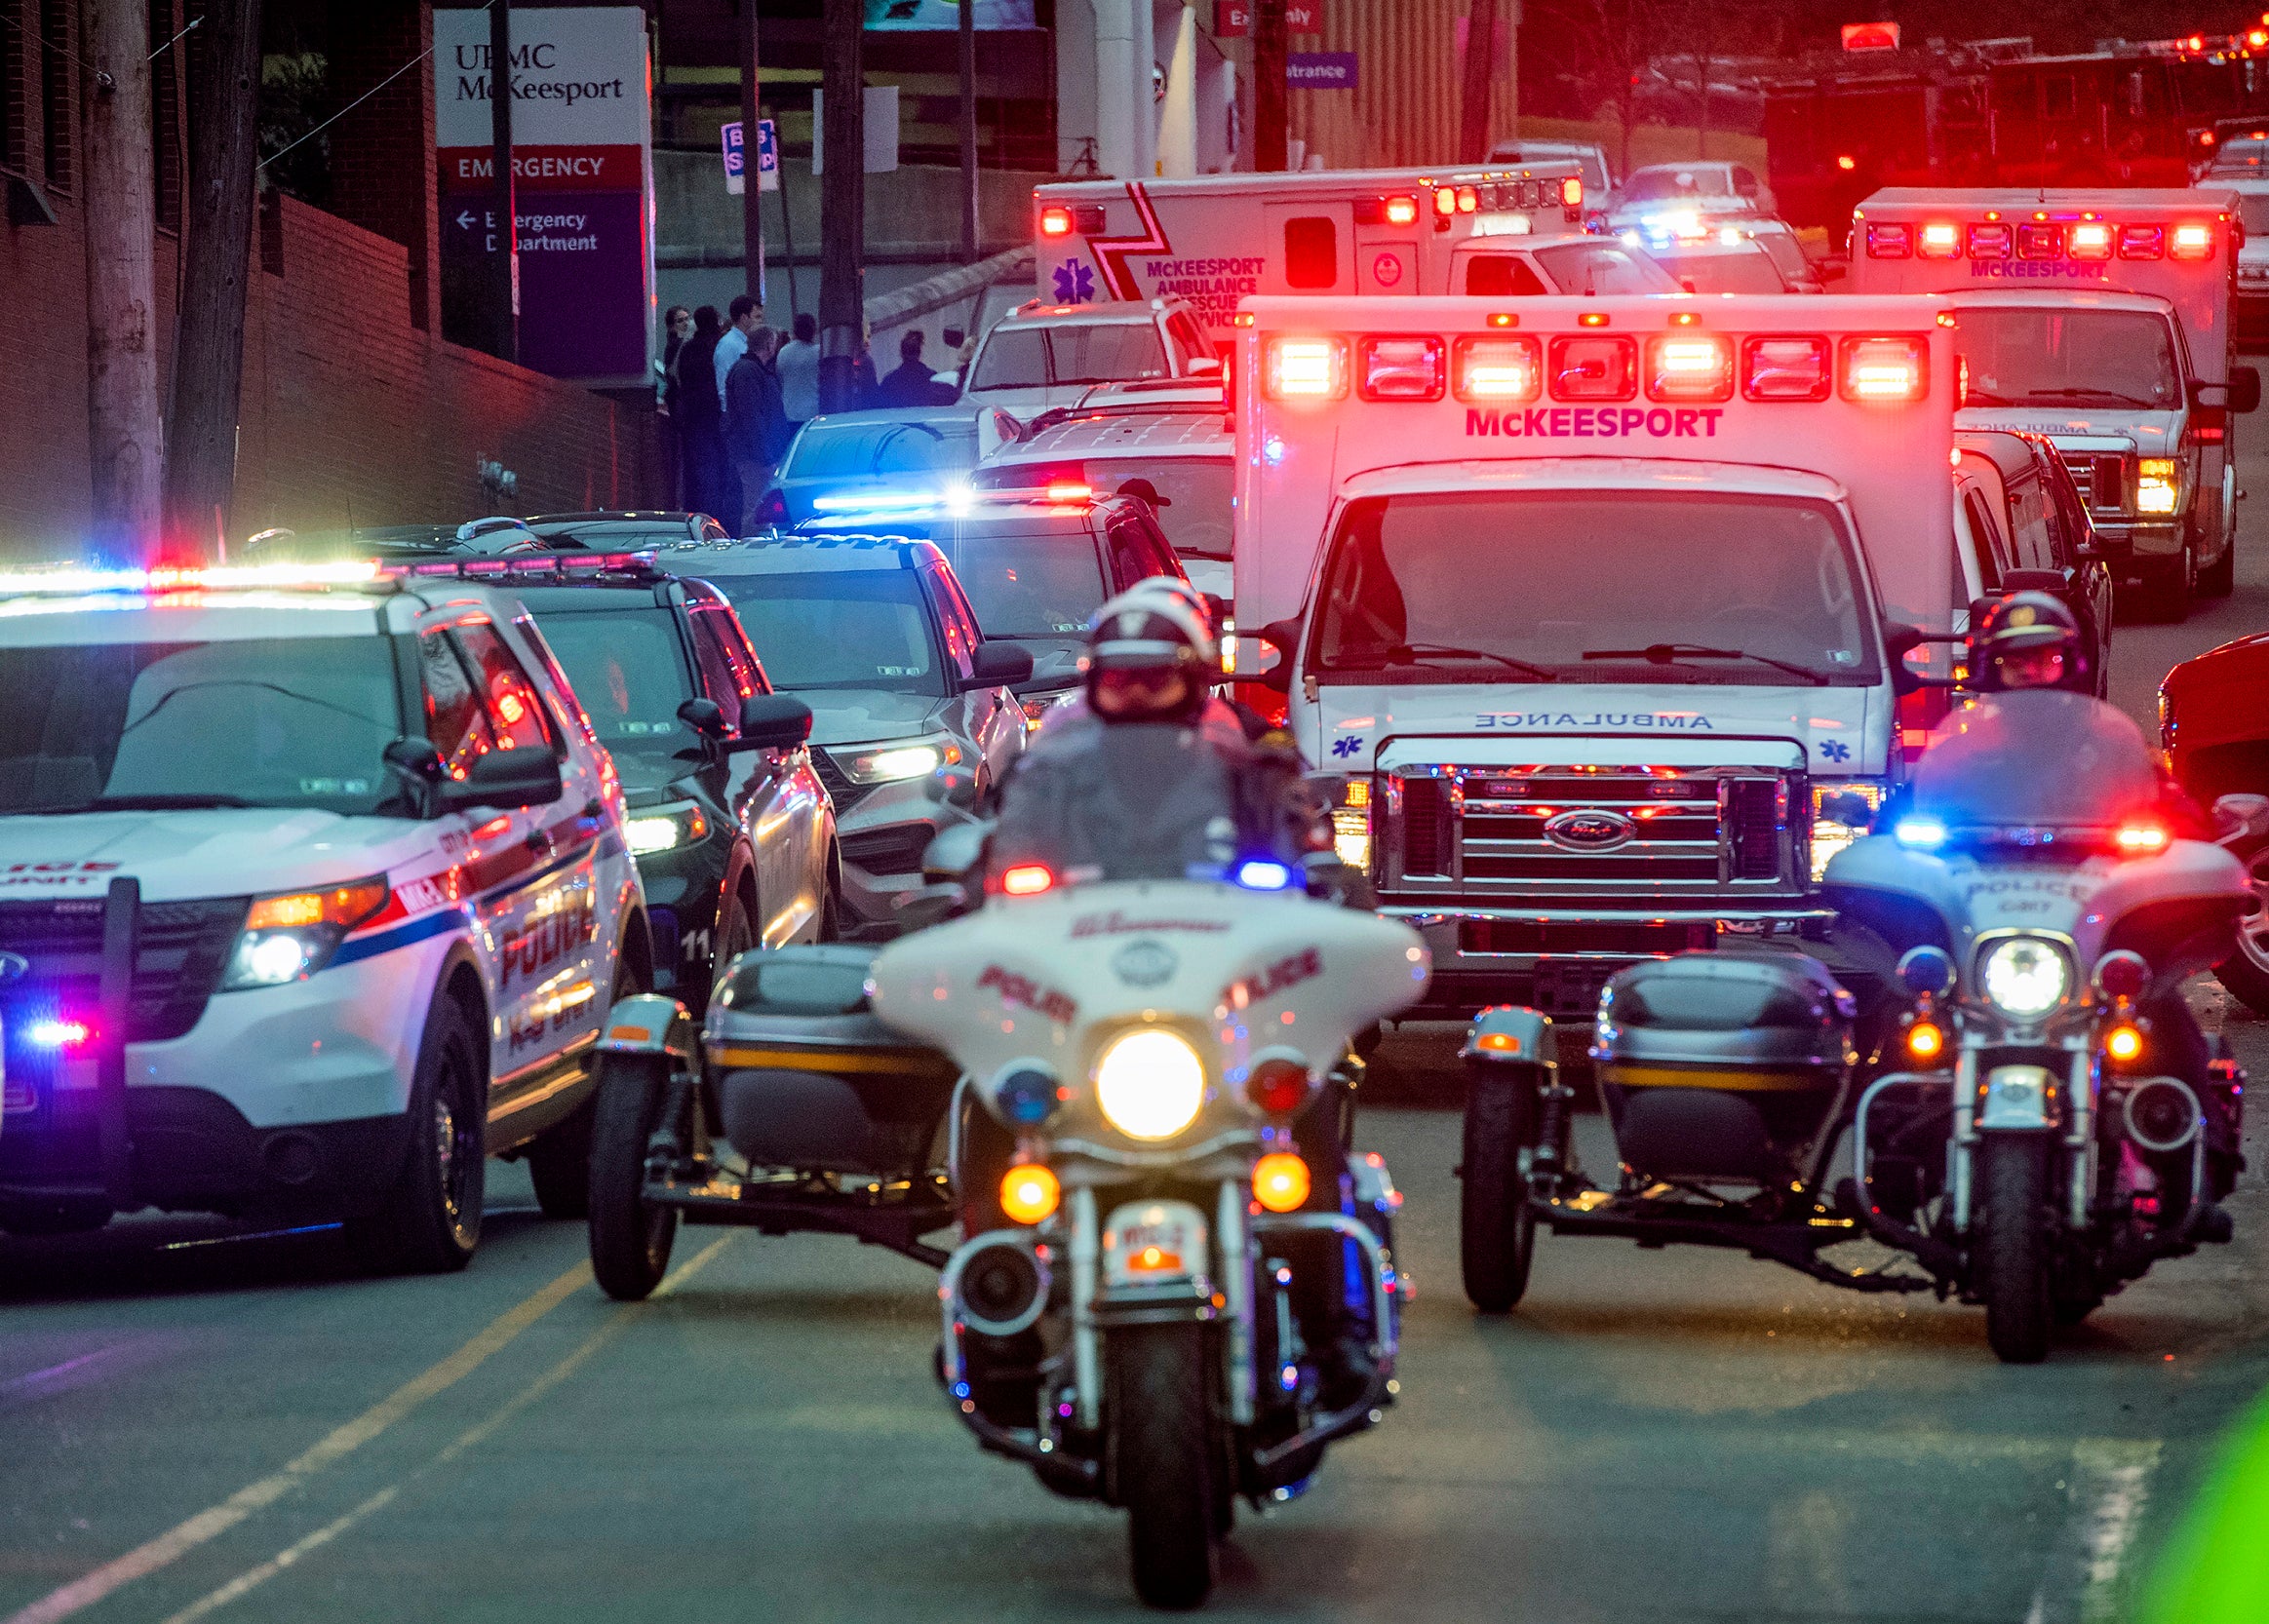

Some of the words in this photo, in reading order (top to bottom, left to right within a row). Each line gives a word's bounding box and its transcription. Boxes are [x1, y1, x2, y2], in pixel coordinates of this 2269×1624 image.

[1286, 63, 1347, 79] trance
[729, 128, 767, 148] BS
[458, 157, 606, 178] EMRGENCY
[726, 152, 773, 172] SP
[485, 210, 587, 233] Eergency
[485, 234, 599, 252] Dartment
[1156, 277, 1257, 296] AMBULANCE
[1180, 293, 1237, 311] ESCUE
[1466, 408, 1724, 438] McKEESPORT
[681, 928, 710, 962] 11
